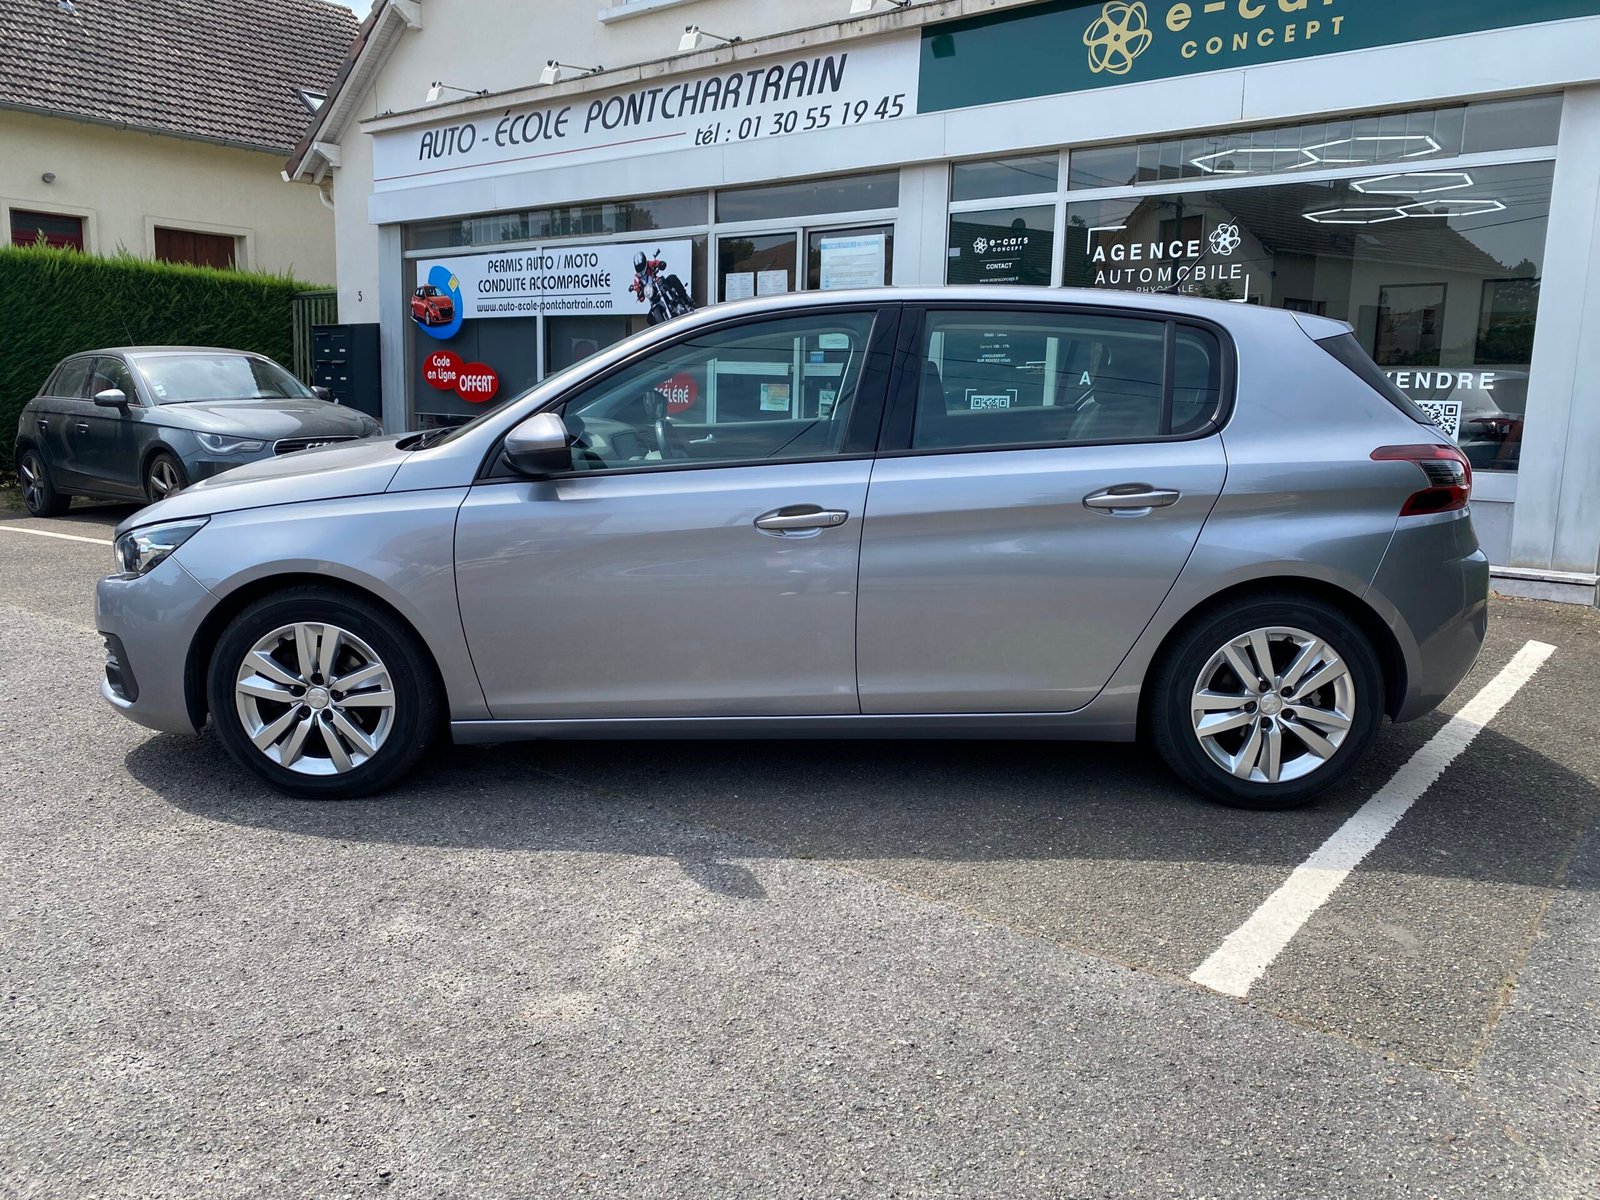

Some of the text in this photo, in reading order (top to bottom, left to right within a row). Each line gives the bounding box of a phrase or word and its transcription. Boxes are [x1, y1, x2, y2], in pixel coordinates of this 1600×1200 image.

[1166, 0, 1334, 32] e-c
[1180, 16, 1344, 59] CONCEPT
[419, 123, 476, 160] AUTO
[495, 106, 571, 147] ÉCOLE
[584, 53, 848, 133] PONTCHARTRAIN
[694, 123, 721, 146] tél
[738, 116, 762, 140] 01
[769, 110, 798, 136] 30
[803, 105, 832, 131] 55
[841, 99, 869, 125] 19
[874, 93, 906, 119] 45
[989, 236, 1029, 247] e-cars
[1092, 239, 1201, 263] AGENCE
[487, 257, 523, 274] PERMIS
[526, 255, 554, 272] AUTO
[563, 252, 599, 270] MOTO
[986, 262, 1013, 270] CONTACT
[1094, 263, 1243, 285] AUTOMOBILE
[478, 269, 611, 293] CONDUITE ACCOMPAGNÉE
[357, 290, 363, 302] 5
[476, 298, 613, 313] www.auto-ecole-pontchartrain.com
[432, 355, 451, 367] Code
[427, 368, 457, 382] en Ligne
[1386, 371, 1495, 389] ENDRE
